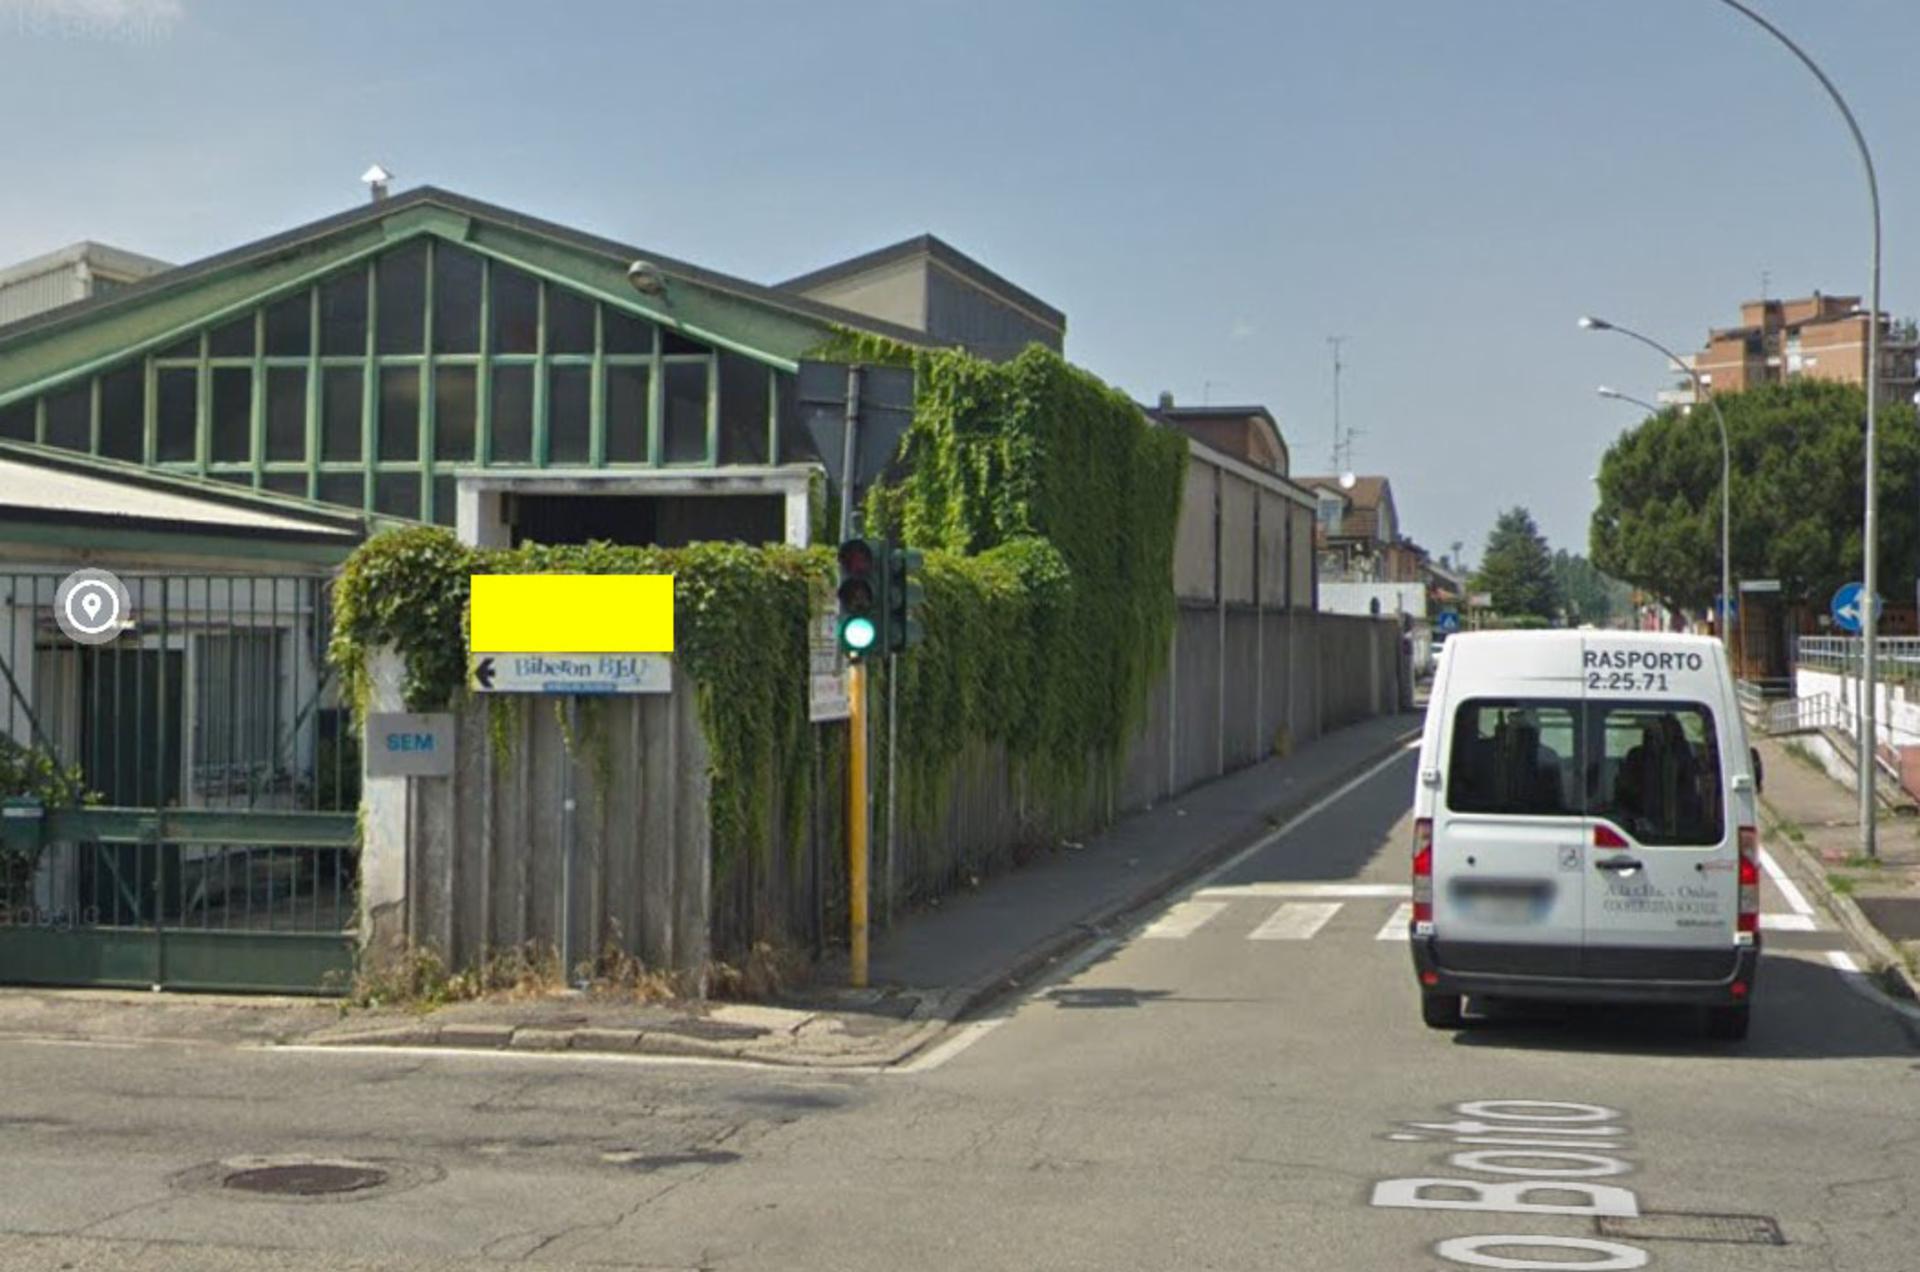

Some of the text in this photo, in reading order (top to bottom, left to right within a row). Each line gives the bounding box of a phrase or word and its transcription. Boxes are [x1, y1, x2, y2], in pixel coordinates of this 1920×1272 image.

[1583, 649, 1703, 671] RASPORTO
[1588, 671, 1668, 692] 2.25.71
[386, 732, 435, 752] SEM
[1369, 1099, 1640, 1217] Boito
